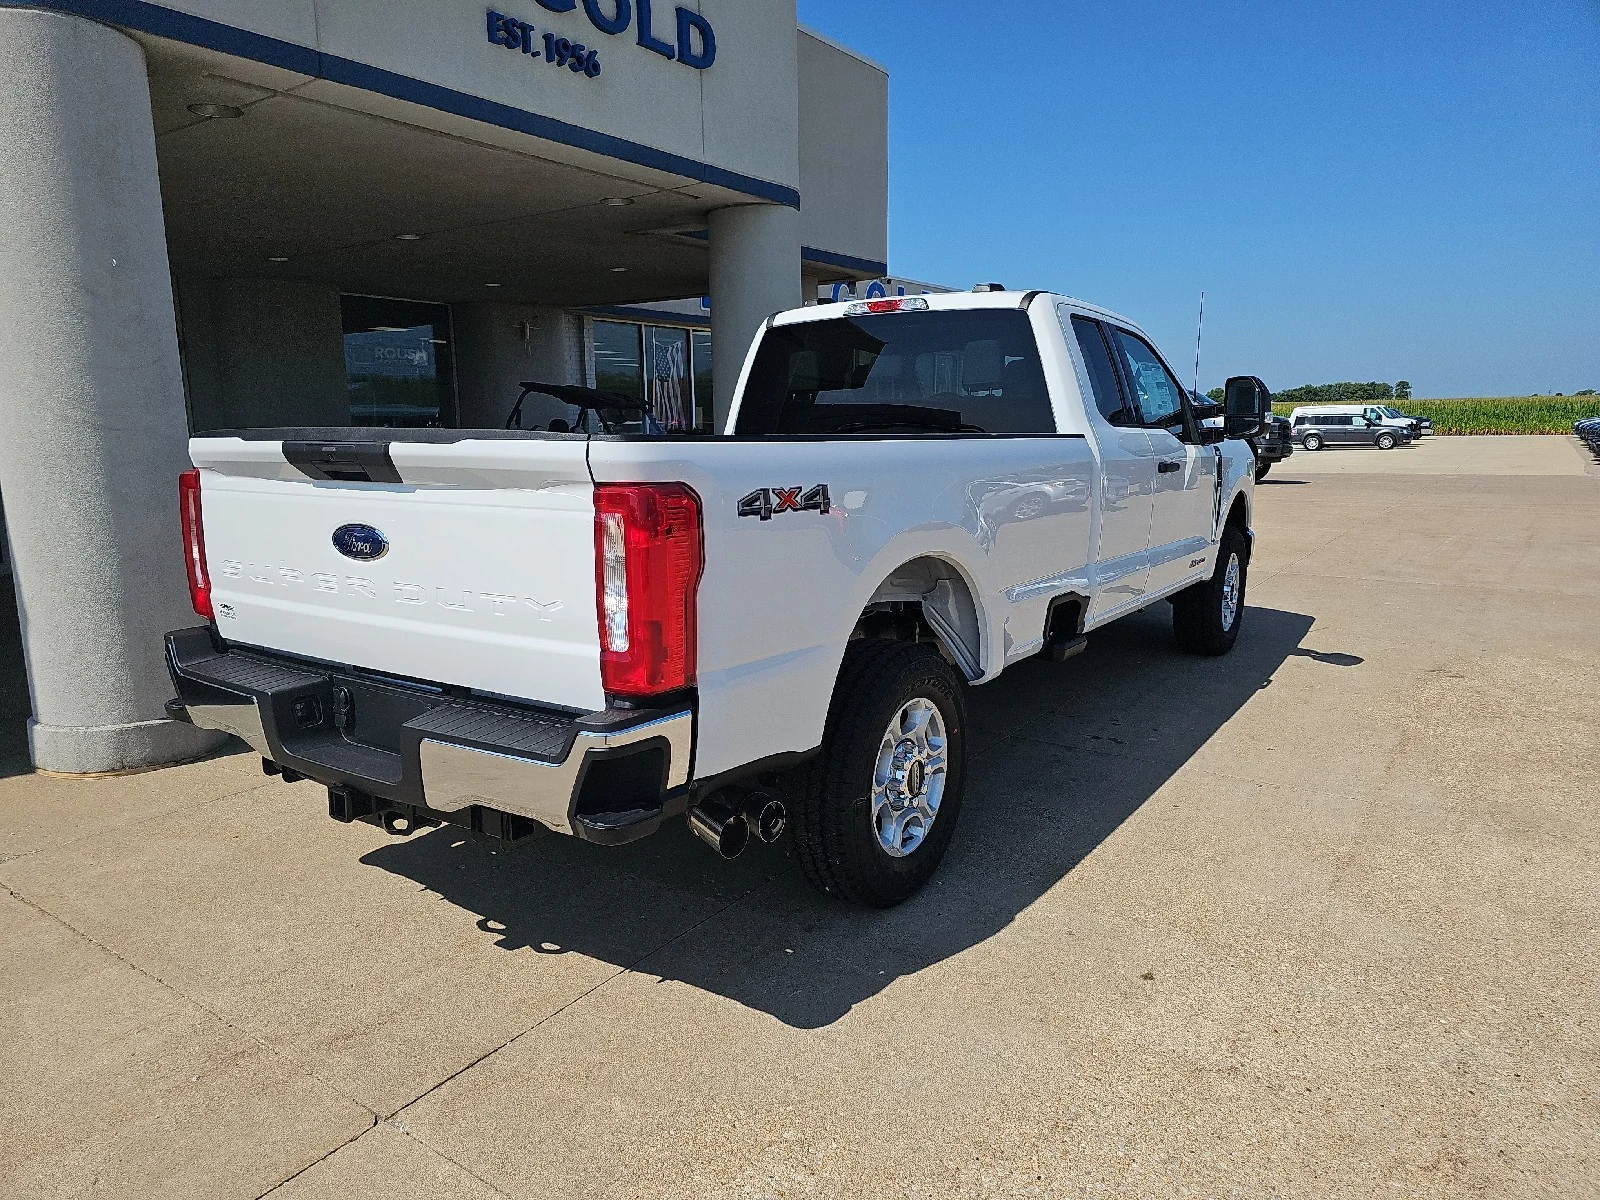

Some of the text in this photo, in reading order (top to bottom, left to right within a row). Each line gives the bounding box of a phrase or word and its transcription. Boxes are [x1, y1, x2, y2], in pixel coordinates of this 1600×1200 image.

[535, 0, 716, 69] OLD
[221, 559, 564, 622] SUPER DUTY
